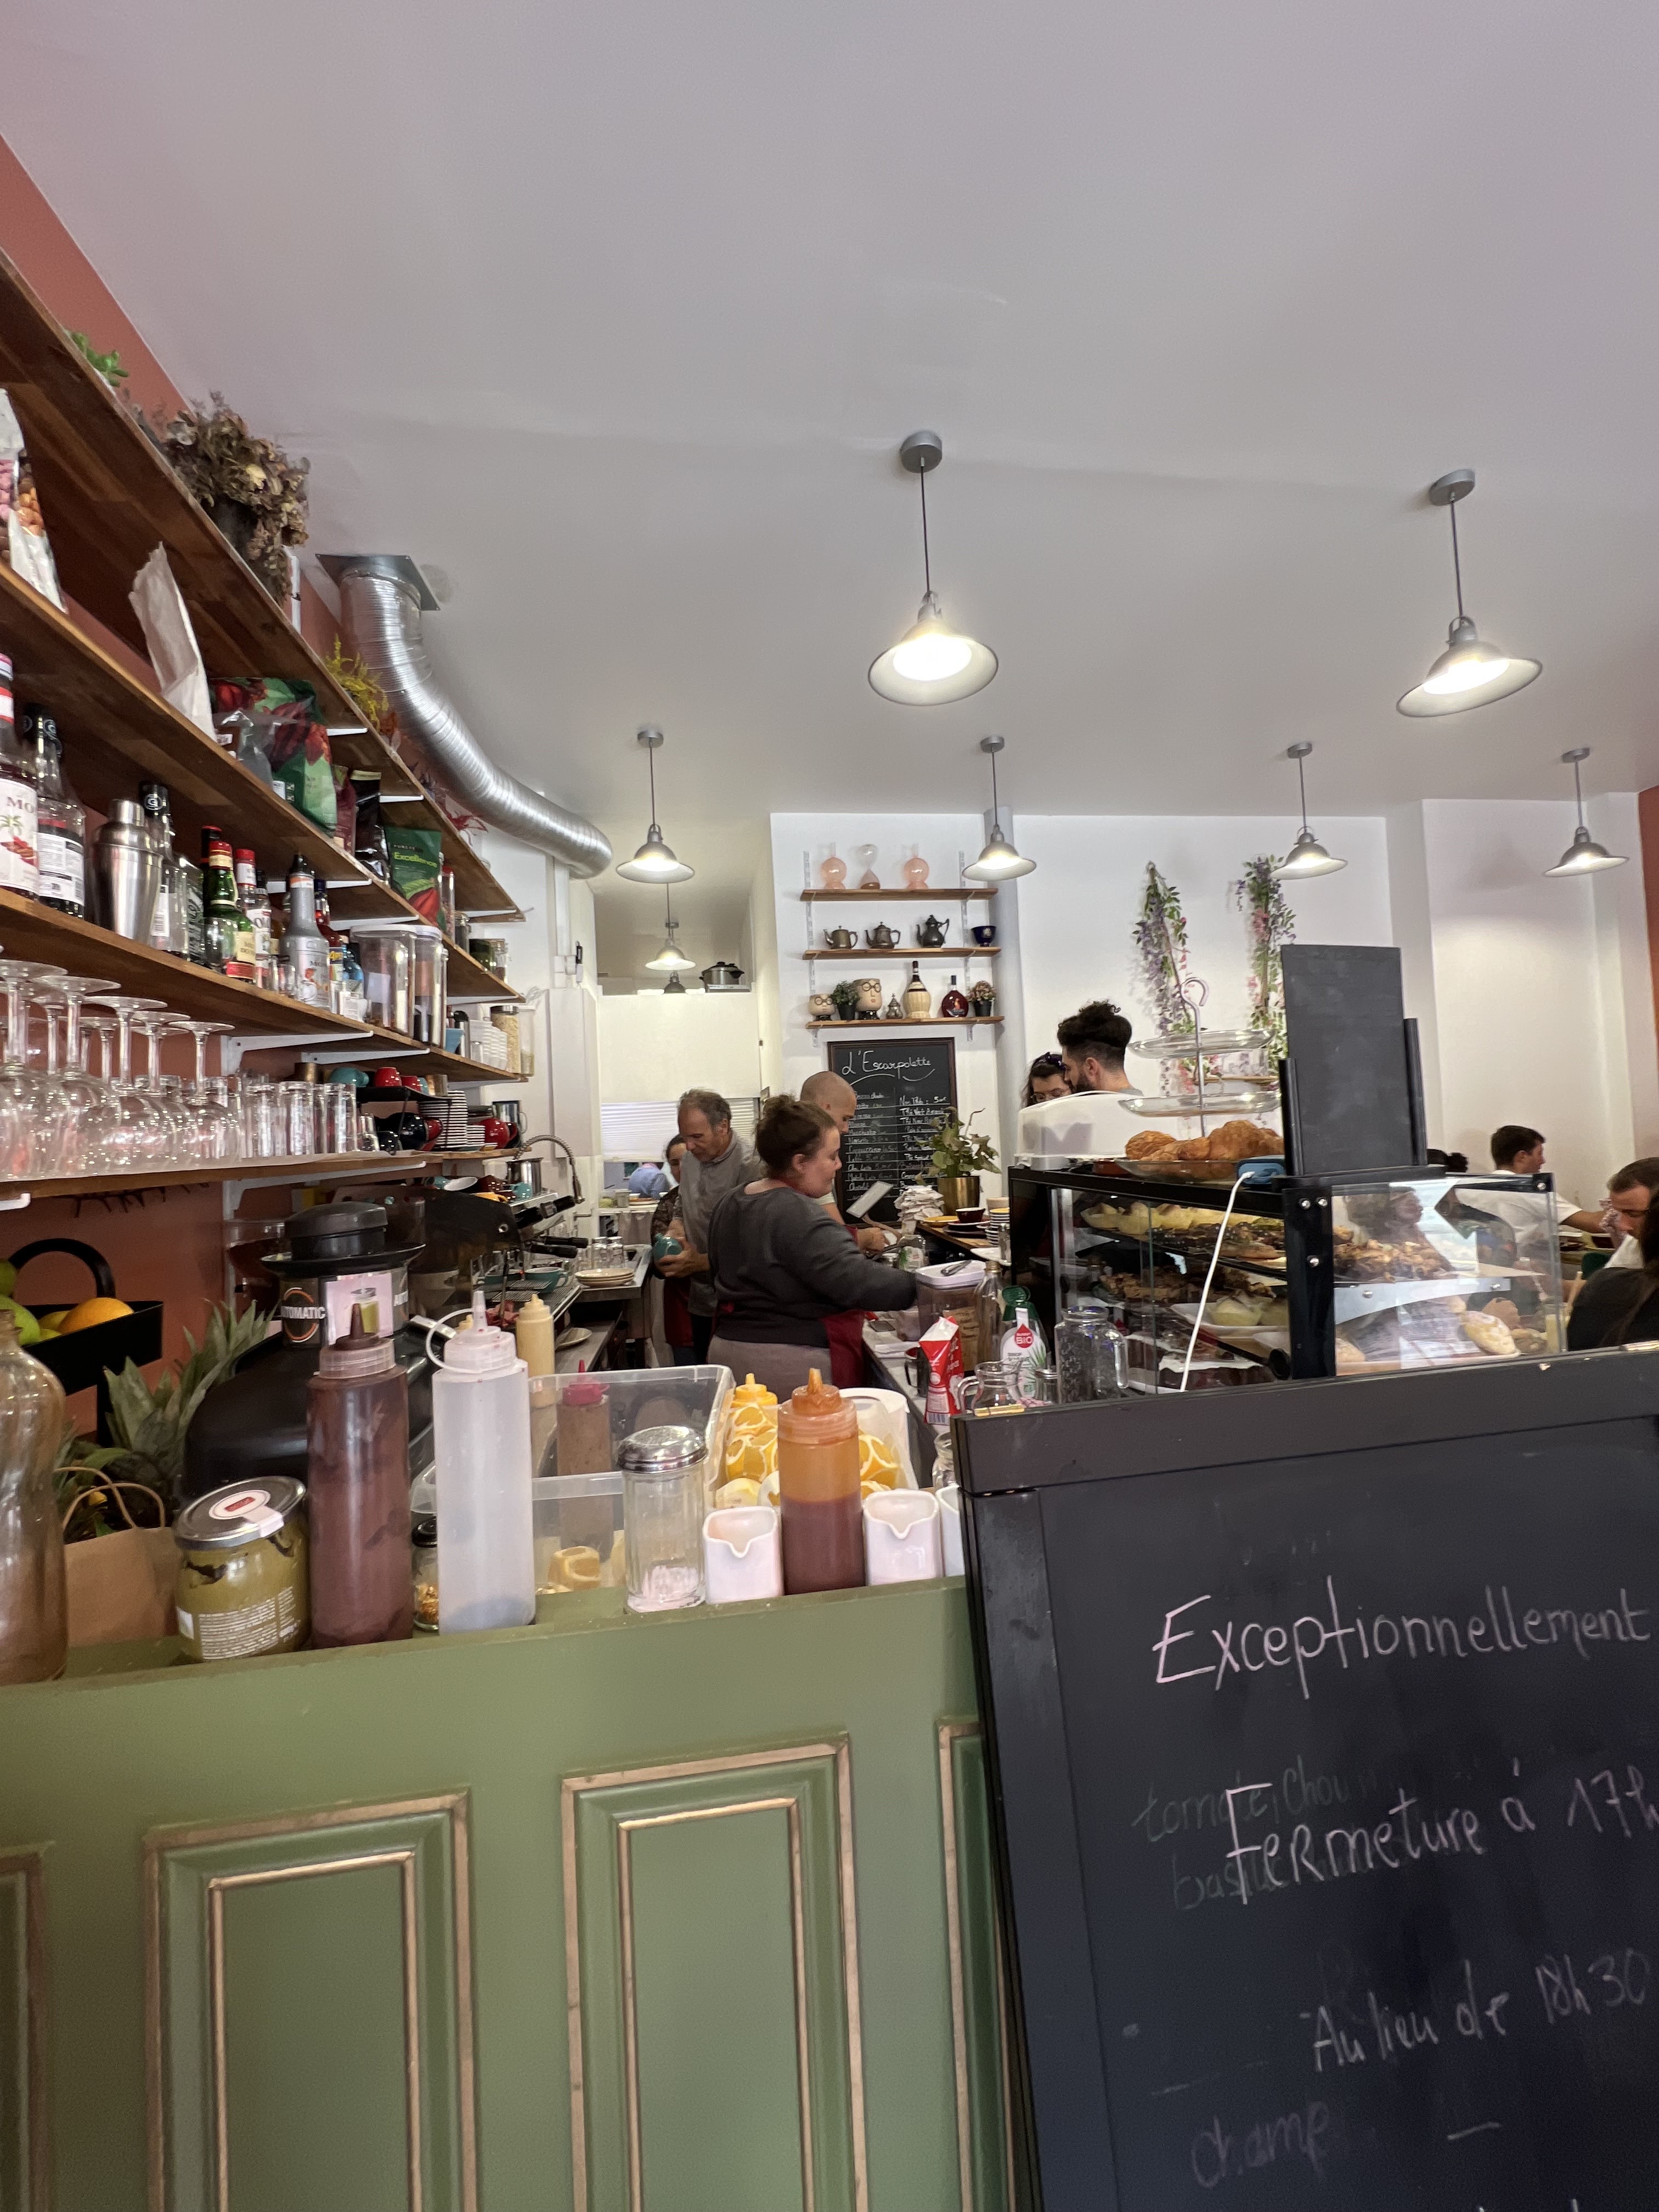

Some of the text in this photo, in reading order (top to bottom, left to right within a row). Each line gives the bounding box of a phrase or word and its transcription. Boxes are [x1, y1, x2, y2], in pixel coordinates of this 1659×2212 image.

[1152, 1575, 1651, 1700] Exceptionnellement
[1313, 2005, 1367, 2072] Au
[1368, 1991, 1438, 2061] lieu
[1455, 1959, 1510, 2040] de
